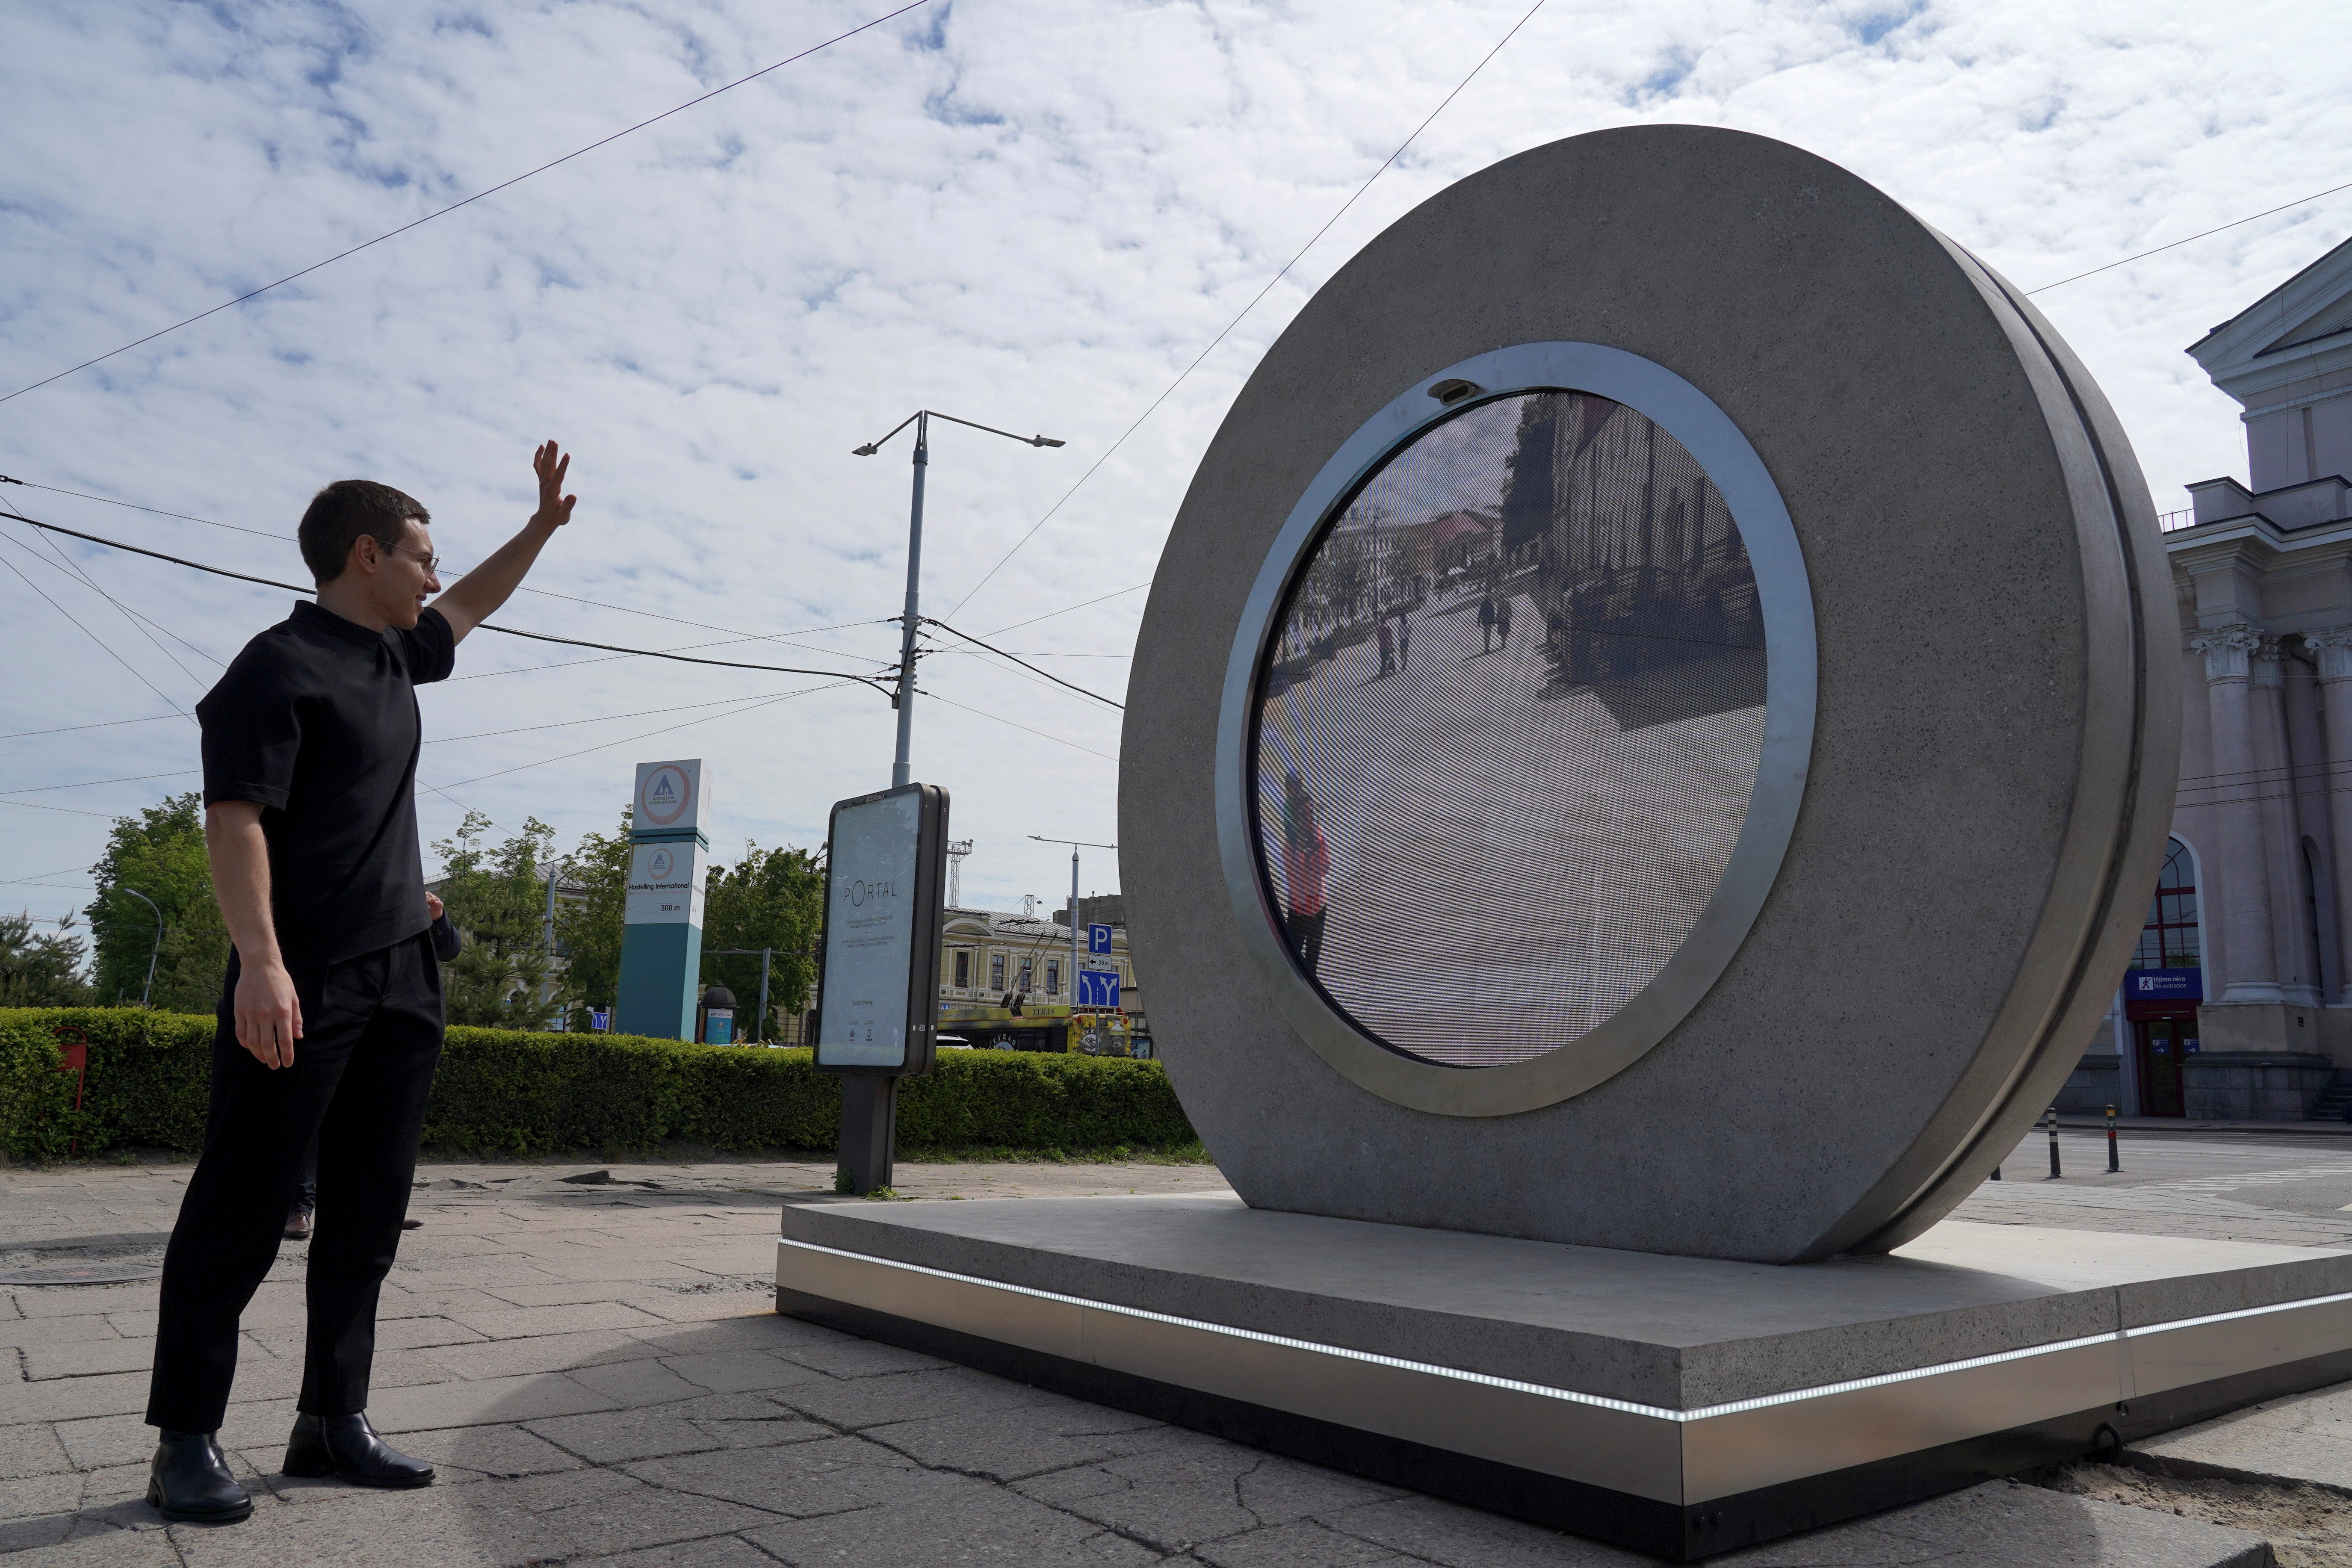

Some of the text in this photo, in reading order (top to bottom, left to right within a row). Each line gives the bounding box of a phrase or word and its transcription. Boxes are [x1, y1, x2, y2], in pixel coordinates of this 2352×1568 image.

[866, 794, 885, 803] JCDecaux
[844, 880, 897, 907] PORTAL
[1095, 927, 1108, 950] P
[1032, 1007, 1055, 1016] TYRAS
[1081, 1029, 1102, 1037] TYRS
[993, 1034, 1016, 1046] TYRAS
